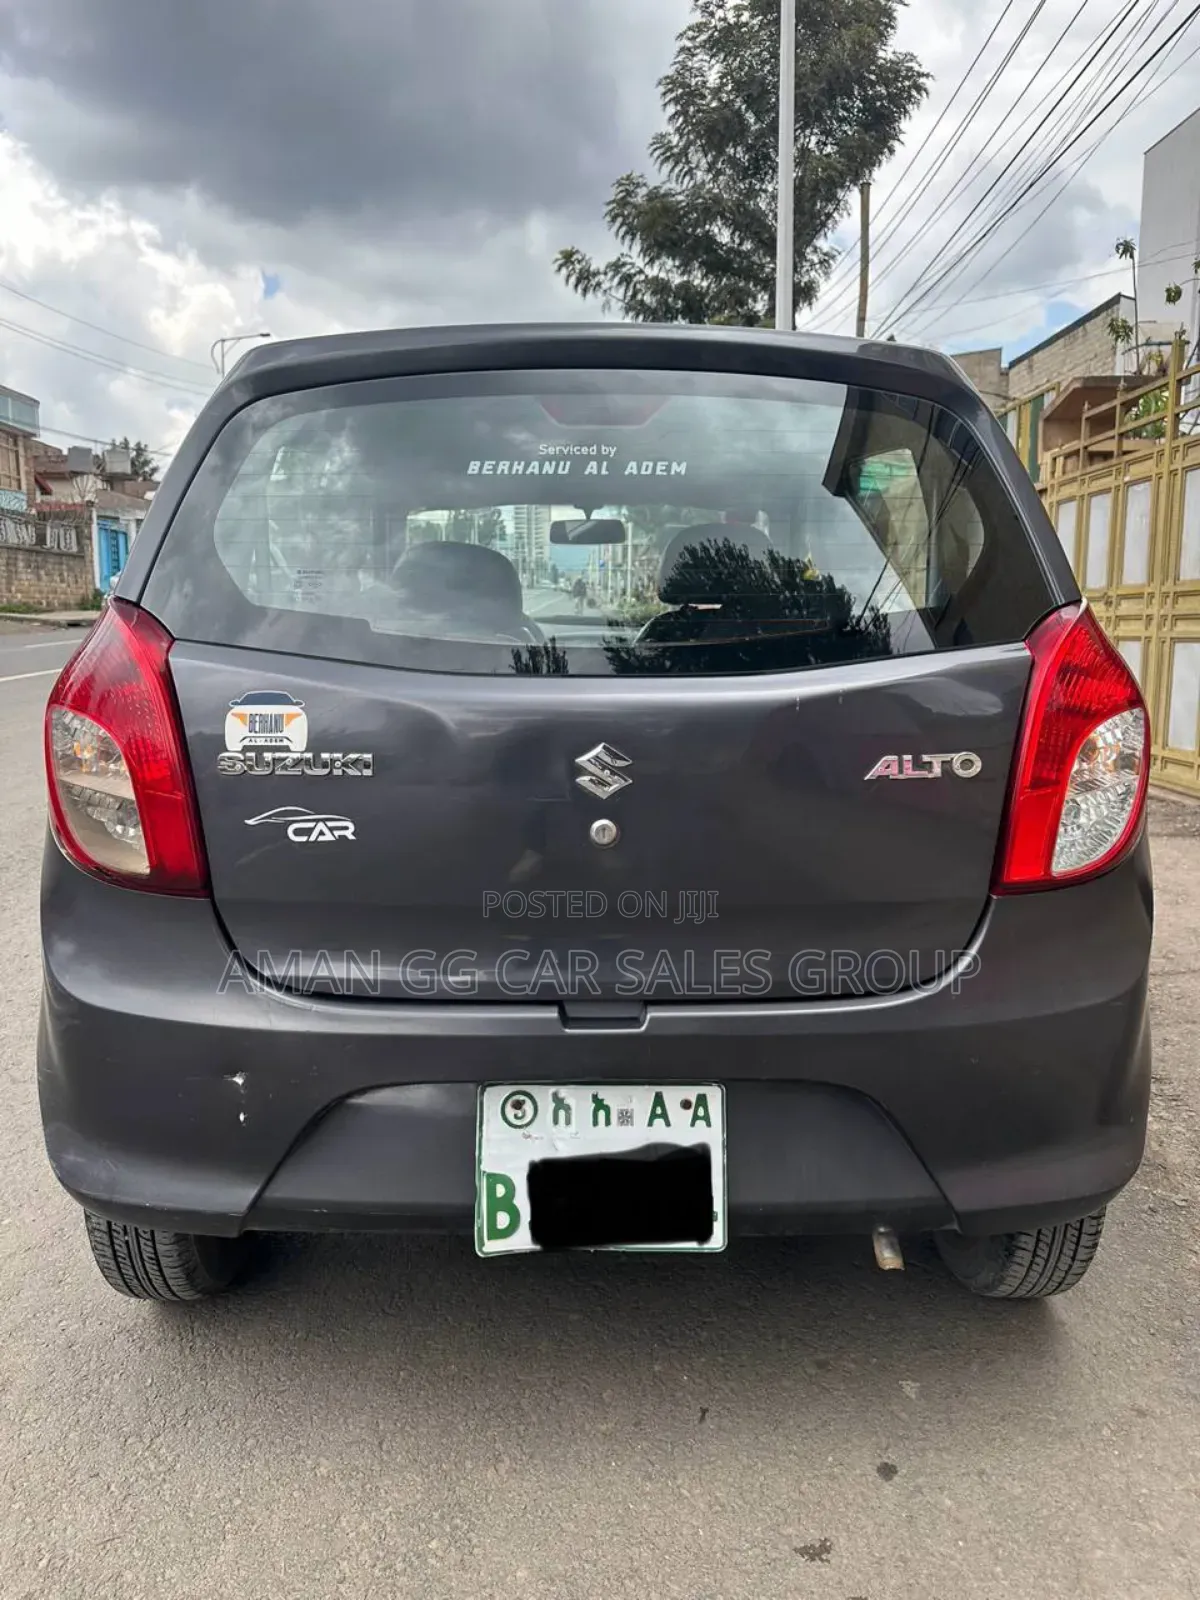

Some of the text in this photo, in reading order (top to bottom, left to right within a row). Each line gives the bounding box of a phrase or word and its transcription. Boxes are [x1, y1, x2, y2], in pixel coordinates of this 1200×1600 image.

[539, 443, 617, 457] Serviced by
[467, 460, 688, 475] BERHANU AL ADEM
[217, 752, 375, 776] SUZUKI
[864, 751, 982, 780] ALTO
[287, 821, 357, 842] CAR
